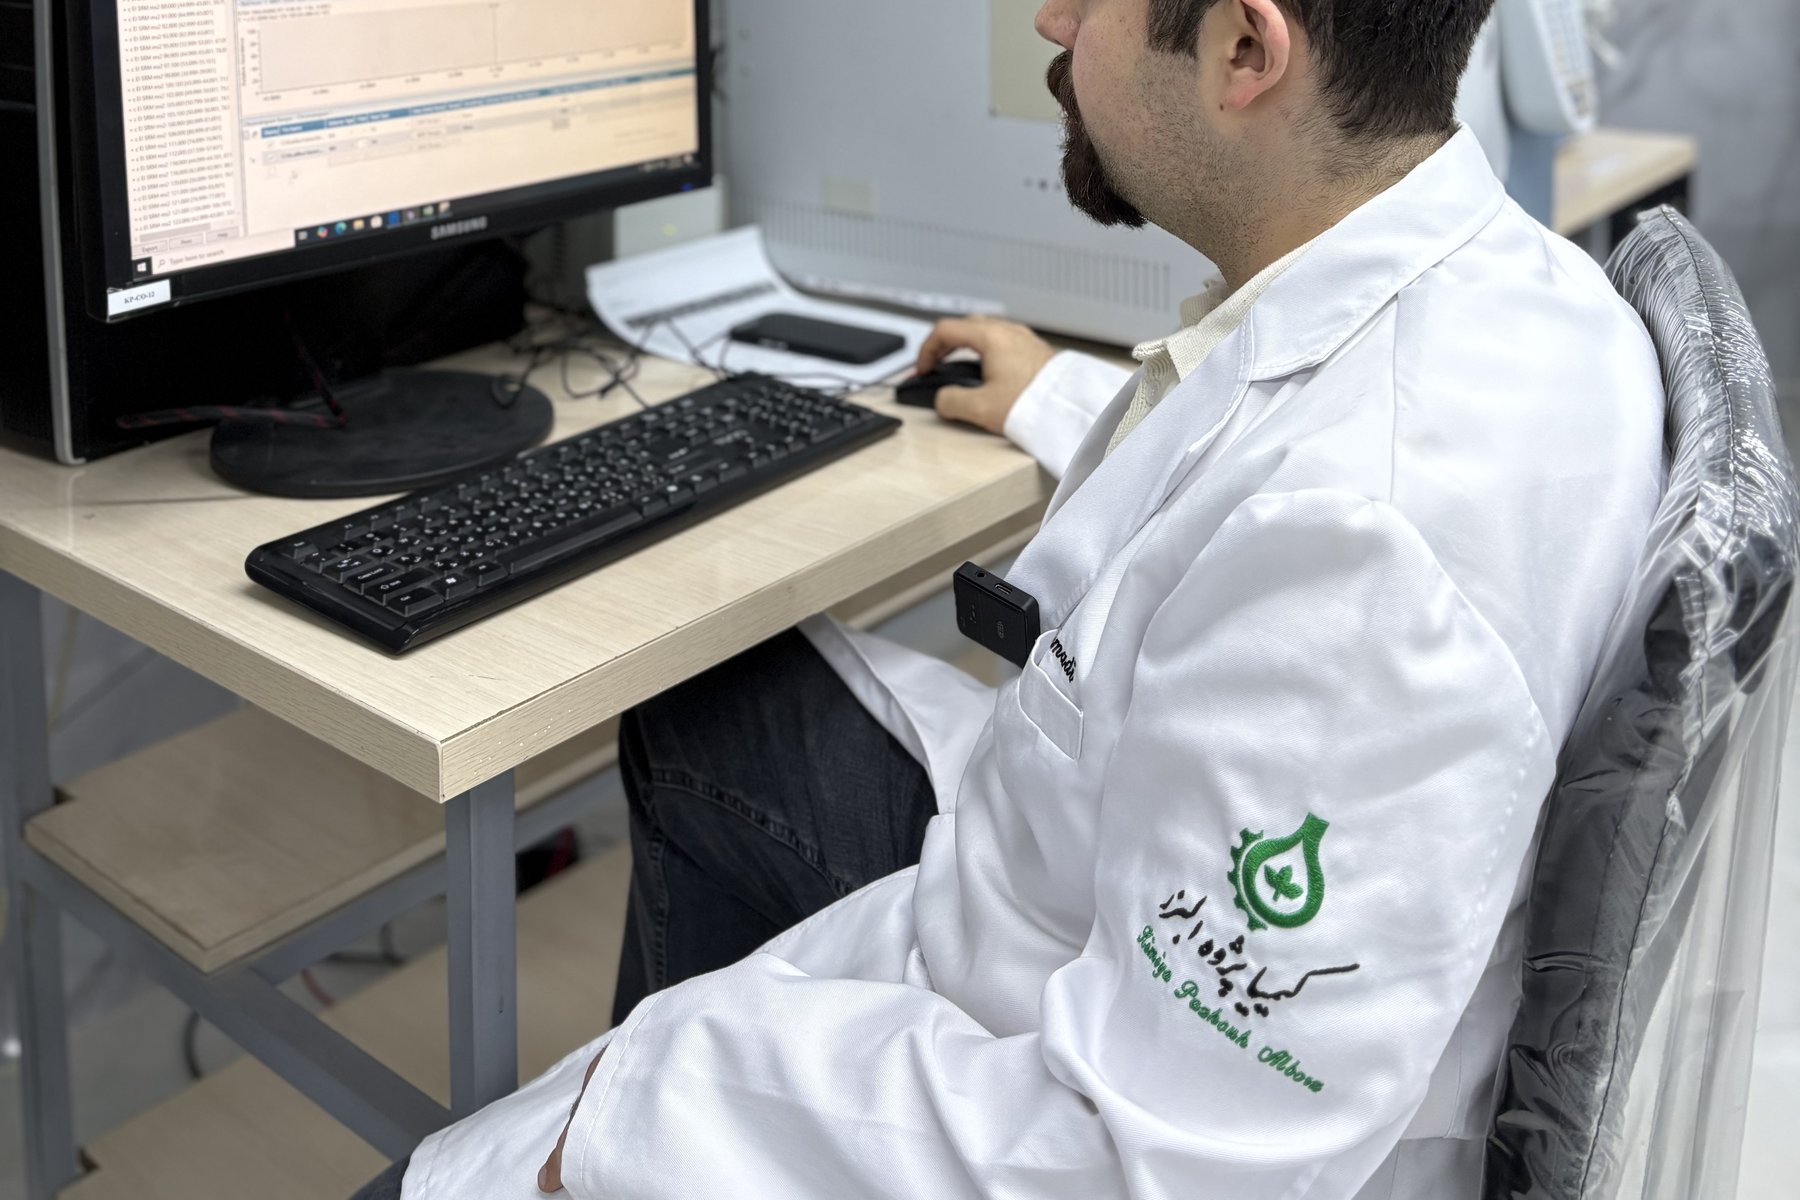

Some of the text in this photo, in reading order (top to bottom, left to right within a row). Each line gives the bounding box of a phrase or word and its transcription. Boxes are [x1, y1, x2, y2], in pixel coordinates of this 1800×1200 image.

[430, 216, 488, 240] SAMSUNG
[170, 257, 183, 266] Type
[124, 291, 155, 305] KP-CO-12
[1257, 1045, 1325, 1093] Alborz
